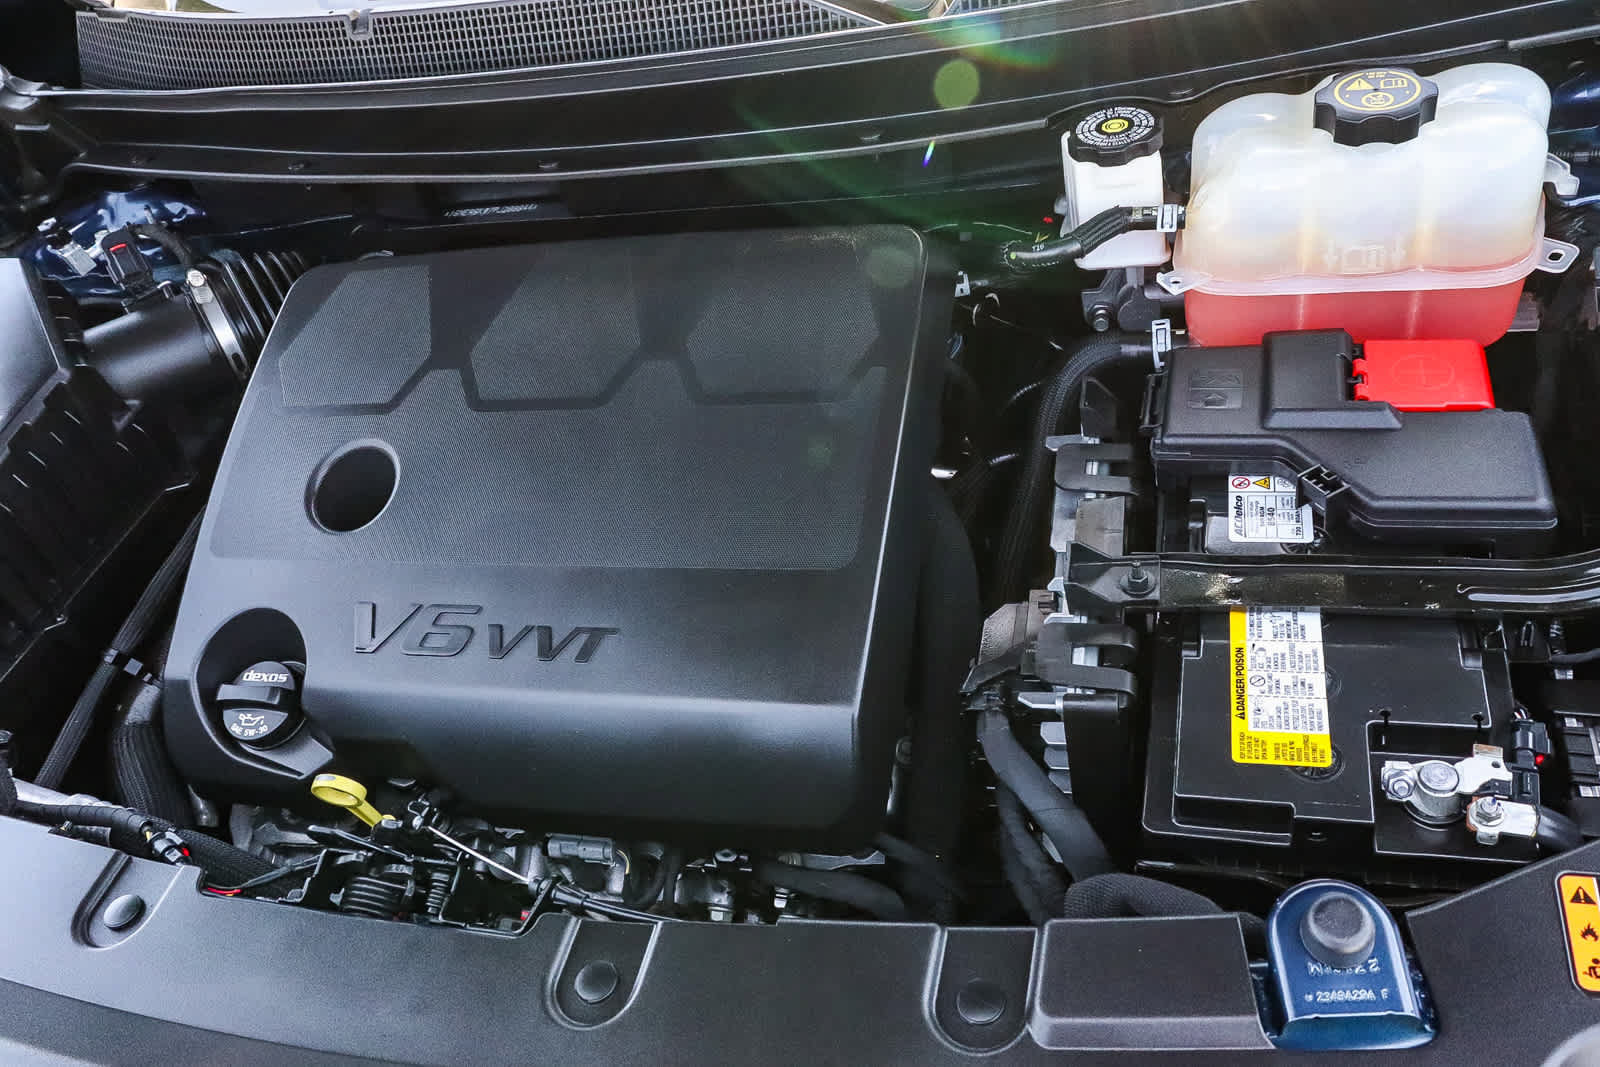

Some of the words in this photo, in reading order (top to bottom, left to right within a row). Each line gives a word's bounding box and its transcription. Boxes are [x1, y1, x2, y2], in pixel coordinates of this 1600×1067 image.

[354, 601, 483, 657] V6
[487, 623, 620, 663] VVT
[242, 670, 288, 683] dexos
